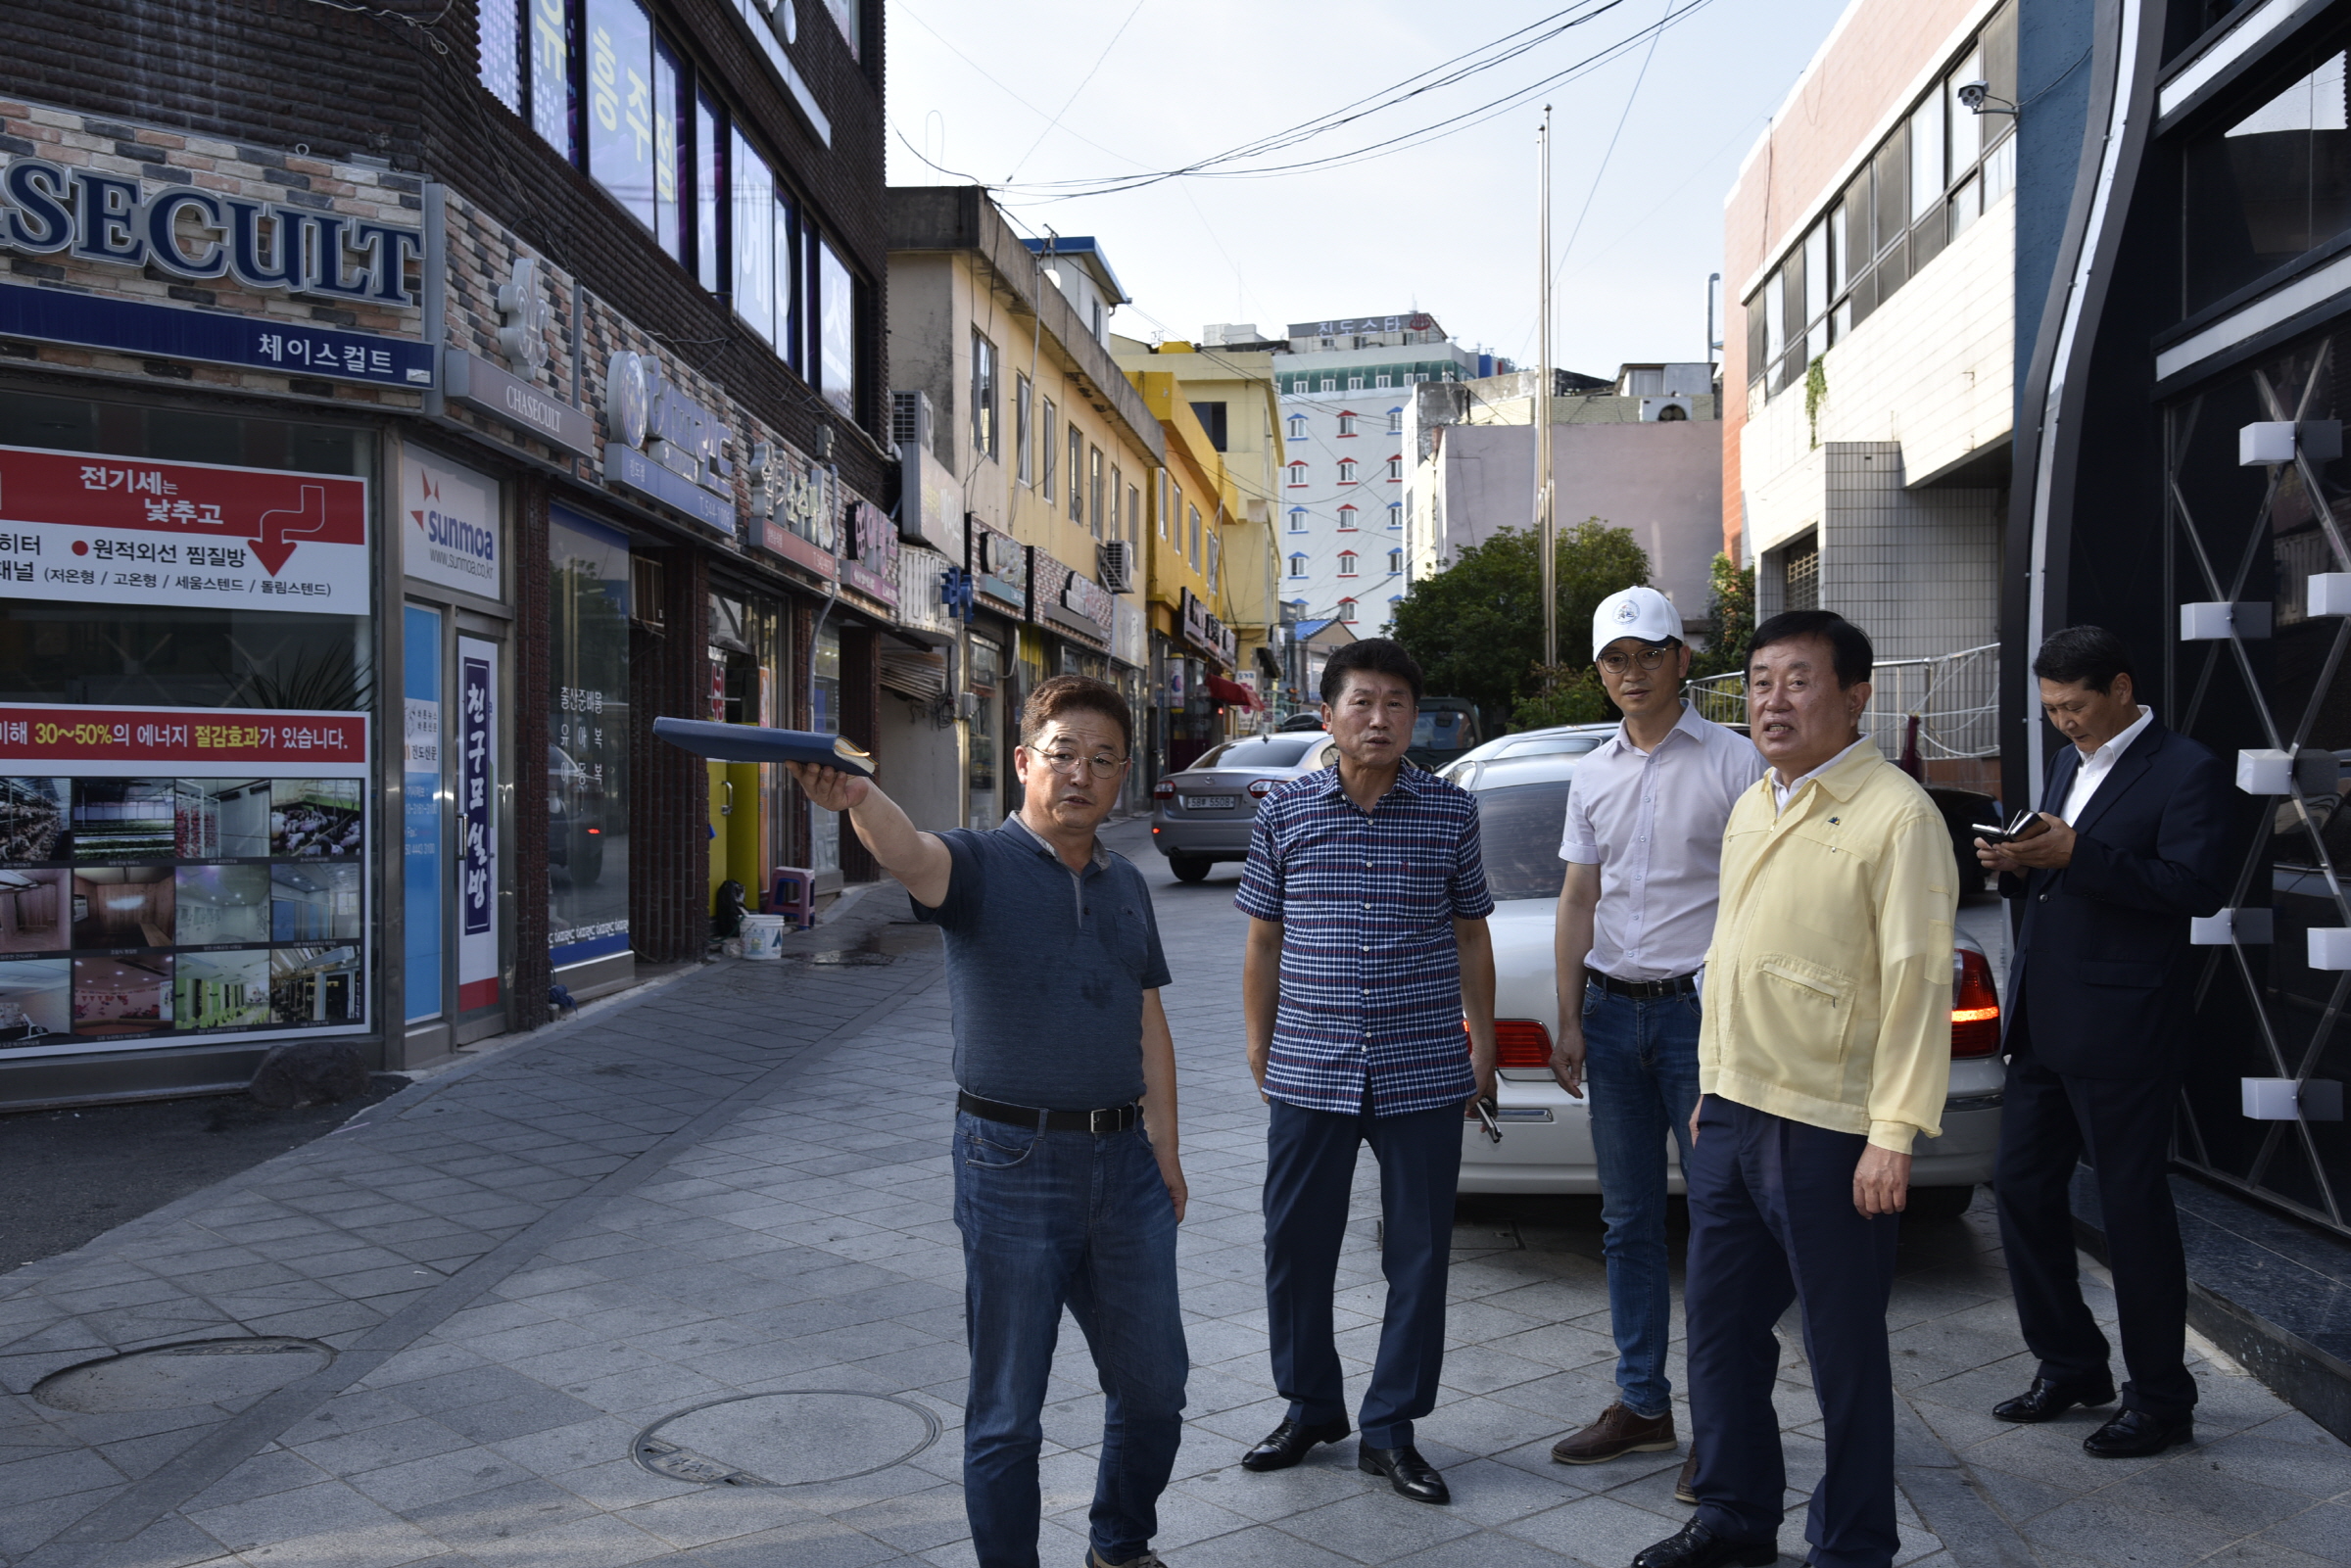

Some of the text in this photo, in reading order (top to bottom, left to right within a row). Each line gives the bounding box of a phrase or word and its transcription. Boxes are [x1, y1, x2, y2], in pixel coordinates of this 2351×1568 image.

[0, 158, 426, 309] SECULT
[1318, 314, 1402, 338] 진도스타
[259, 333, 394, 374] 체이스컬트
[505, 385, 562, 434] CHASECULT
[79, 465, 178, 496] 전기세는
[428, 509, 494, 561] sunmoa
[92, 539, 247, 568] 원적외선 찜질방
[113, 572, 157, 589] 고온형
[560, 686, 602, 714] 출산준비물
[34, 722, 131, 747] 30~50%의
[137, 724, 188, 748] 에너지
[195, 725, 276, 749] 절감효과가
[281, 726, 349, 750] 있습니다.
[411, 744, 438, 761] 진도신문
